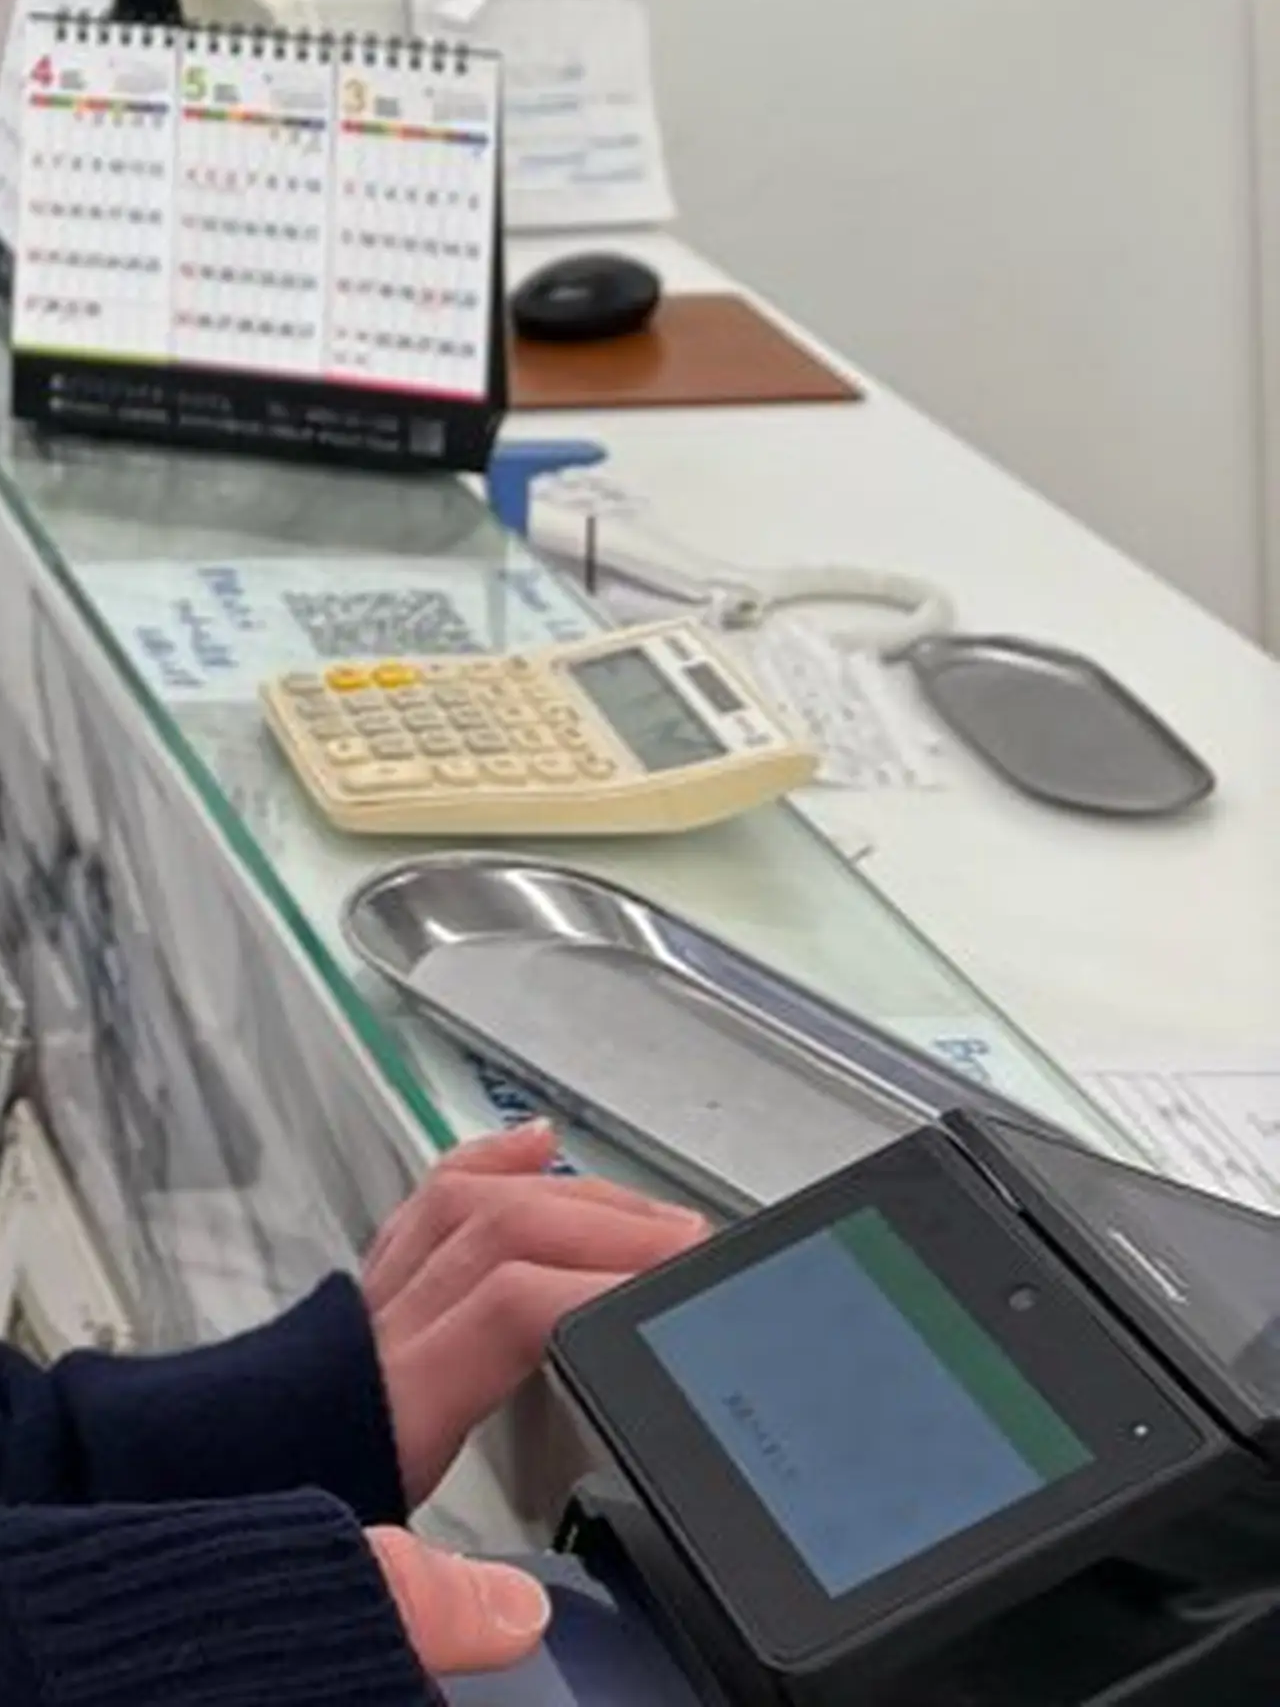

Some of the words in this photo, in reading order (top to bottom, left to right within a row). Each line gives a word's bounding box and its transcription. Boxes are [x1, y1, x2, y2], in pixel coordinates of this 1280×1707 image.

[30, 54, 53, 87] 4
[183, 65, 207, 100] 5
[343, 77, 366, 114] 3
